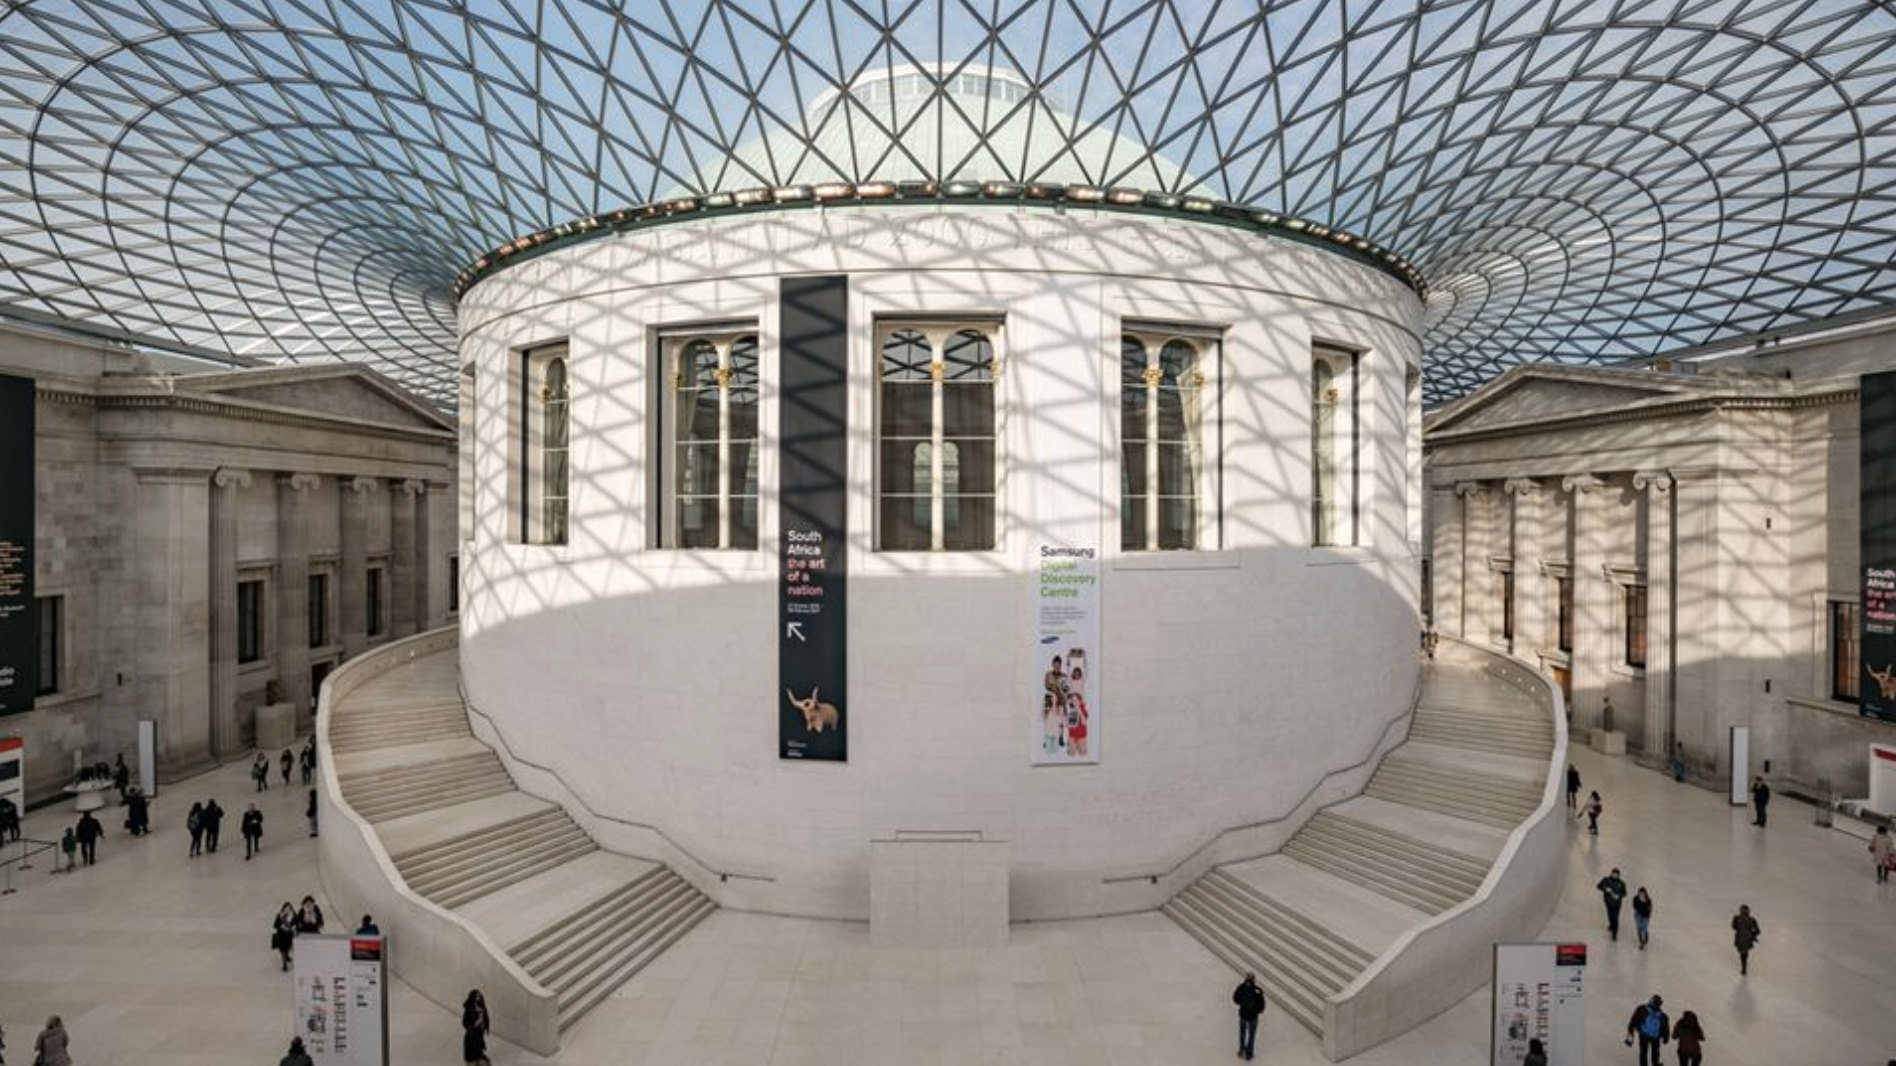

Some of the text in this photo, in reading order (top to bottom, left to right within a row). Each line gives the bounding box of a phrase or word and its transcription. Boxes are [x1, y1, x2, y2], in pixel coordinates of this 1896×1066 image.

[788, 530, 822, 541] South
[787, 544, 821, 555] Africa
[1041, 546, 1095, 559] Samsung
[788, 558, 826, 569] the art
[787, 571, 810, 582] of a
[1867, 568, 1896, 578] South
[1041, 573, 1095, 585] Discovery
[1867, 578, 1895, 589] Africa
[787, 585, 823, 596] nation
[1041, 586, 1077, 597] Centre
